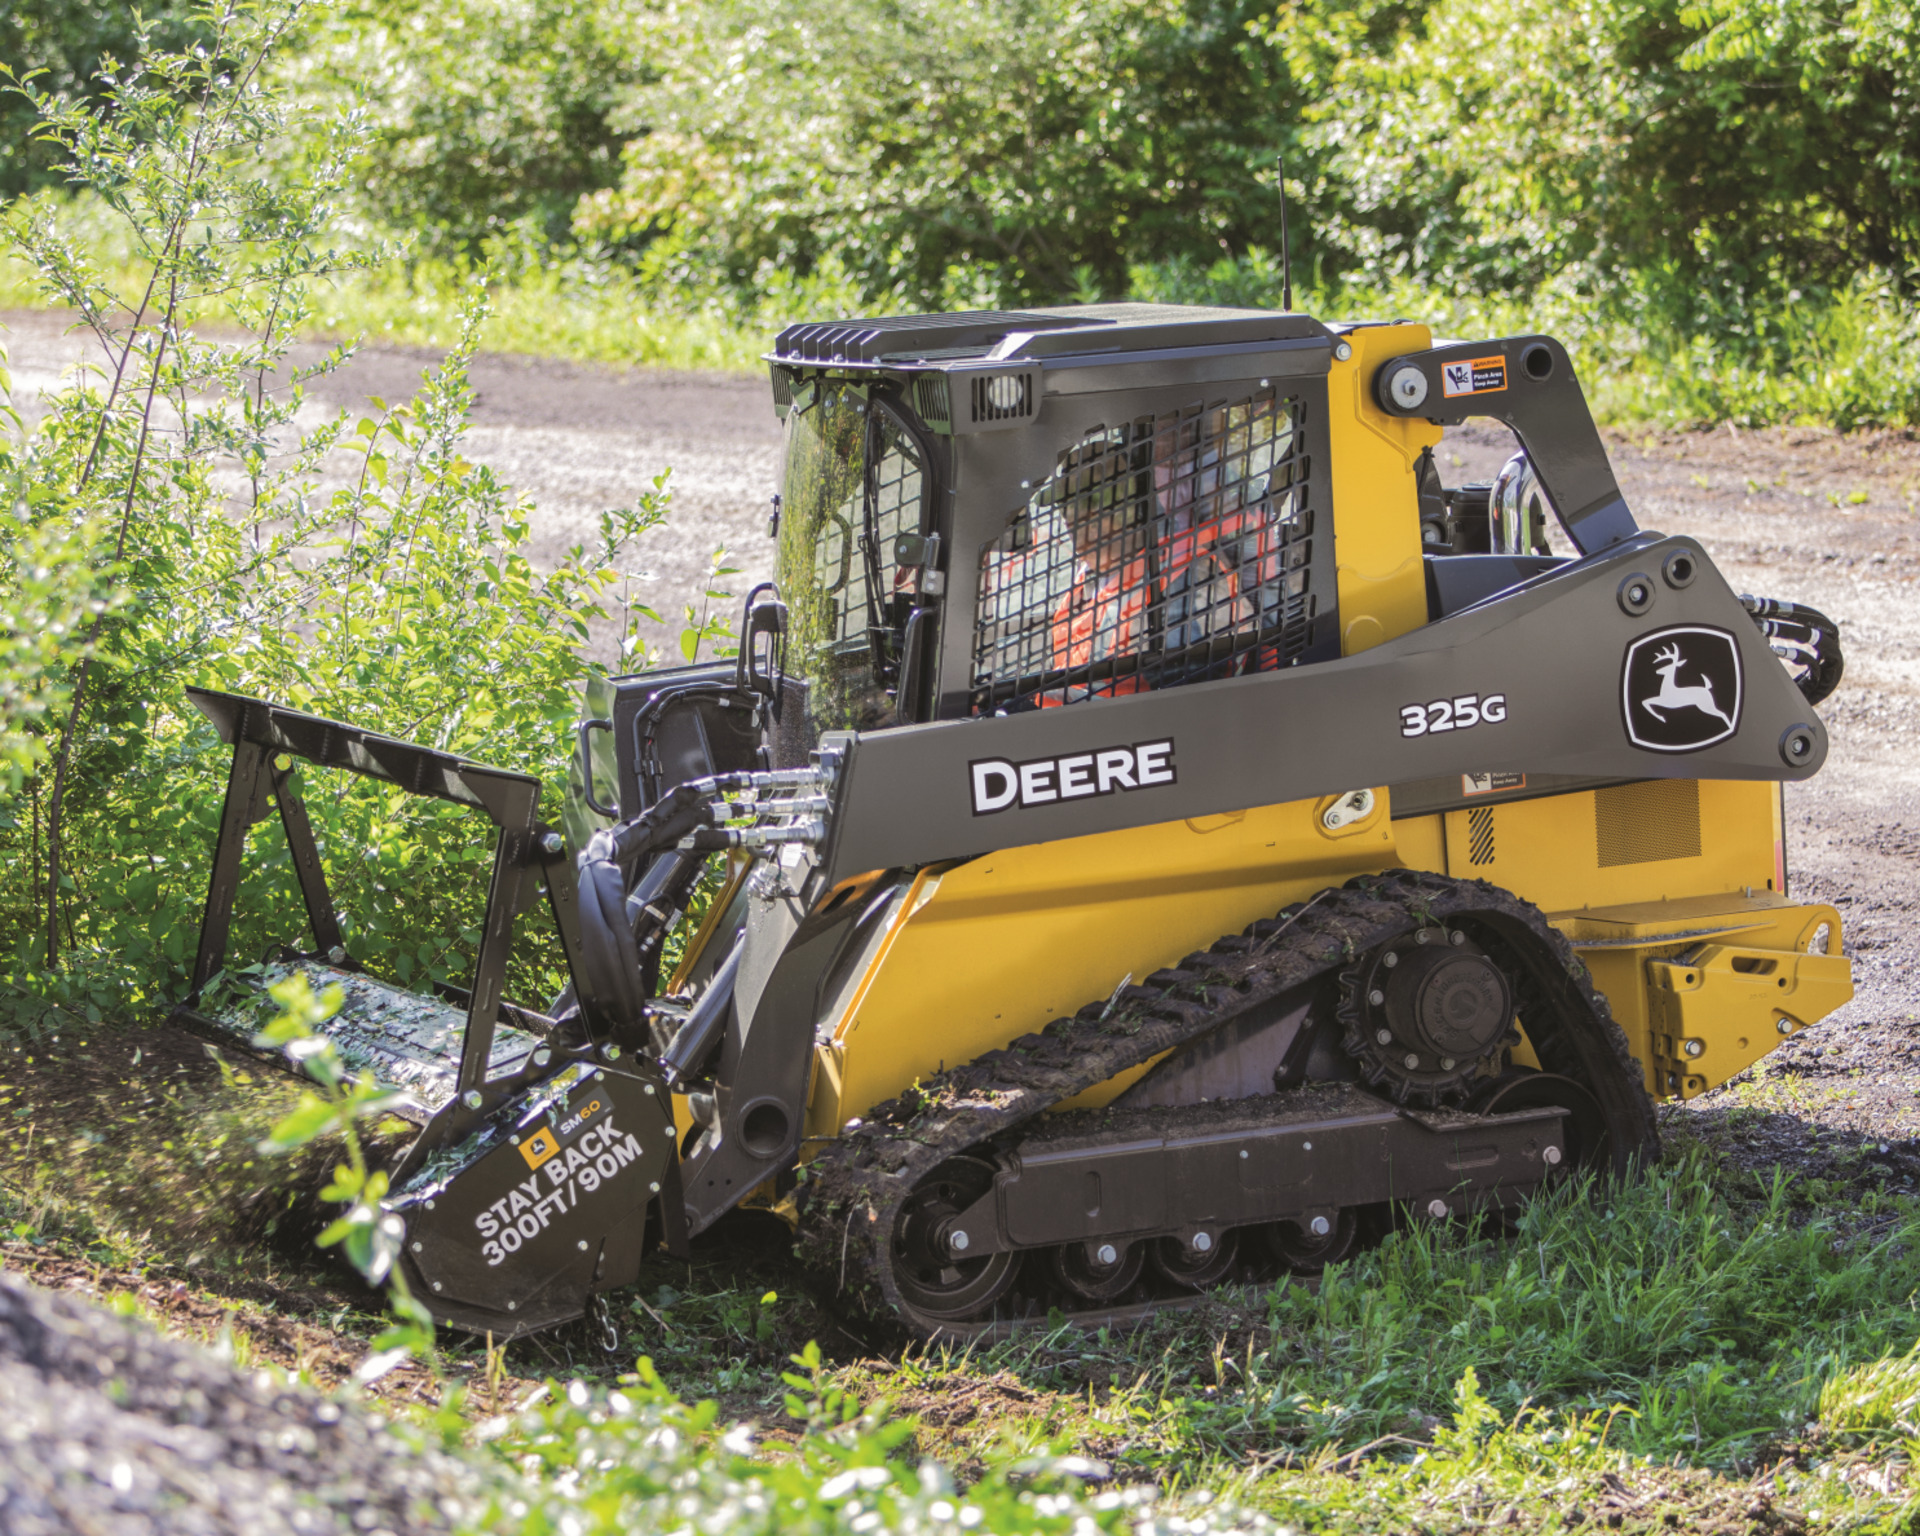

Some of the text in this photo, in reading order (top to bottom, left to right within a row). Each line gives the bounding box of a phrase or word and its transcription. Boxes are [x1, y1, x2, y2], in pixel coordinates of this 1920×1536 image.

[1400, 695, 1505, 737] 325G
[971, 742, 1174, 813] DEERE
[560, 1100, 601, 1134] SM60
[475, 1115, 624, 1237] STAY BACK
[482, 1133, 644, 1266] 300FT/90M
